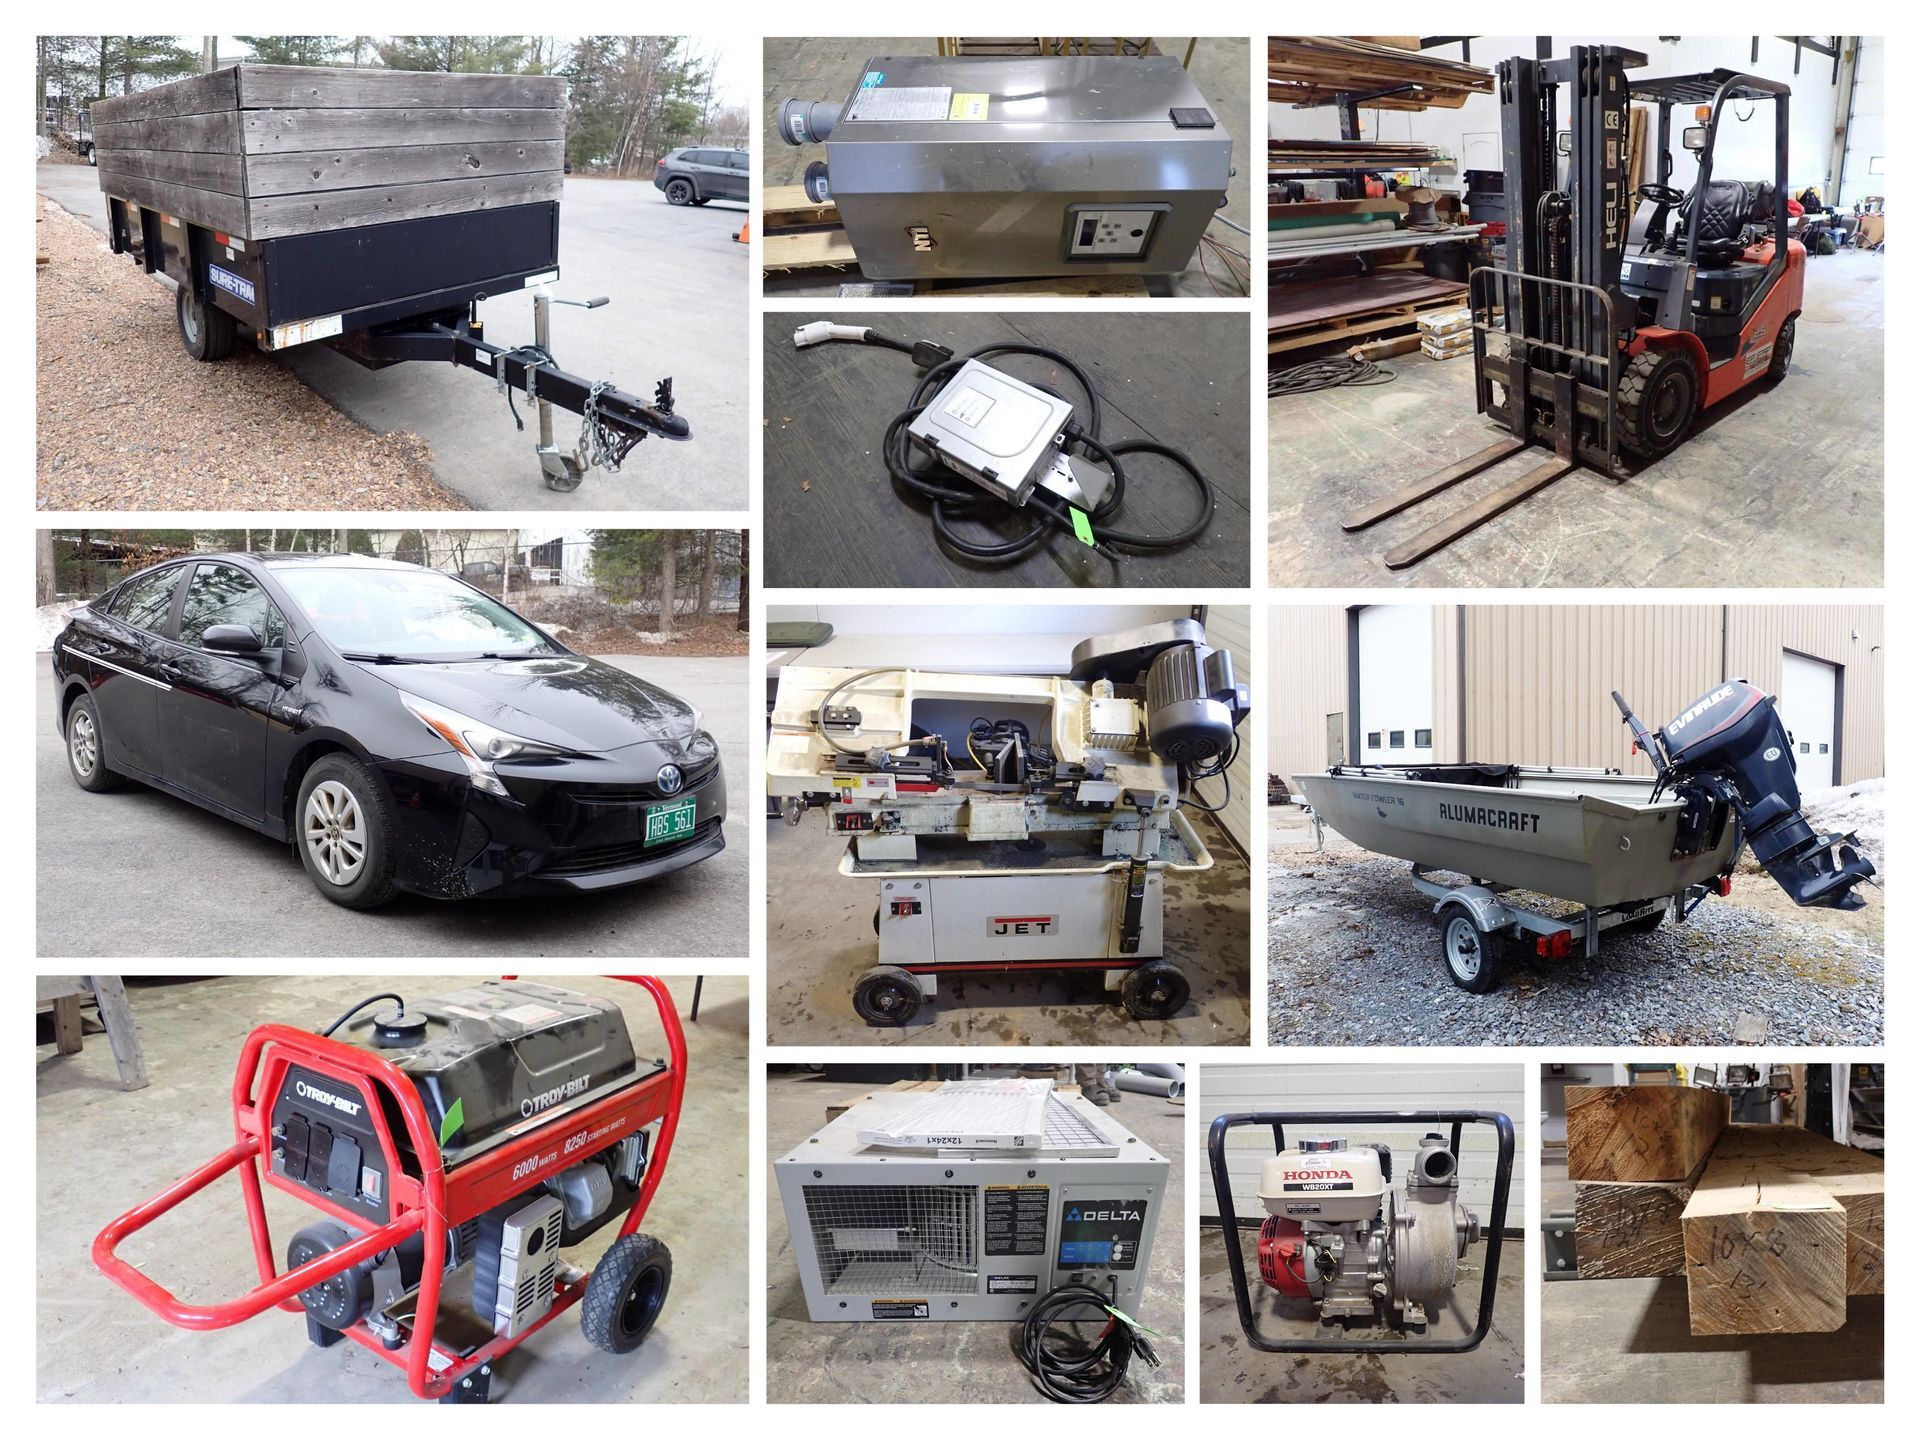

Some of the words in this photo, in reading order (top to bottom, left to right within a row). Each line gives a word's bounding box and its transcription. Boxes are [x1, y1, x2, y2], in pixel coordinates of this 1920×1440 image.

[1606, 182, 1617, 249] HELI
[1668, 684, 1735, 736] EVINRUDE
[651, 814, 670, 838] HBS
[674, 809, 692, 831] 561
[1439, 803, 1540, 834] ALUMACRAFT
[995, 922, 1051, 935] JET
[305, 1085, 362, 1116] TROY-BILT
[532, 1074, 590, 1112] TROY-BILT
[512, 1155, 539, 1181] 6000
[539, 1152, 558, 1168] WATTS
[564, 1131, 588, 1155] 8250
[587, 1125, 610, 1143] STARTING
[610, 1117, 626, 1132] WATTS
[927, 1136, 963, 1144] 12x24x1
[1283, 1170, 1353, 1181] HONDA
[1302, 1183, 1334, 1191] WB20XT
[1083, 1211, 1140, 1221] DELTA
